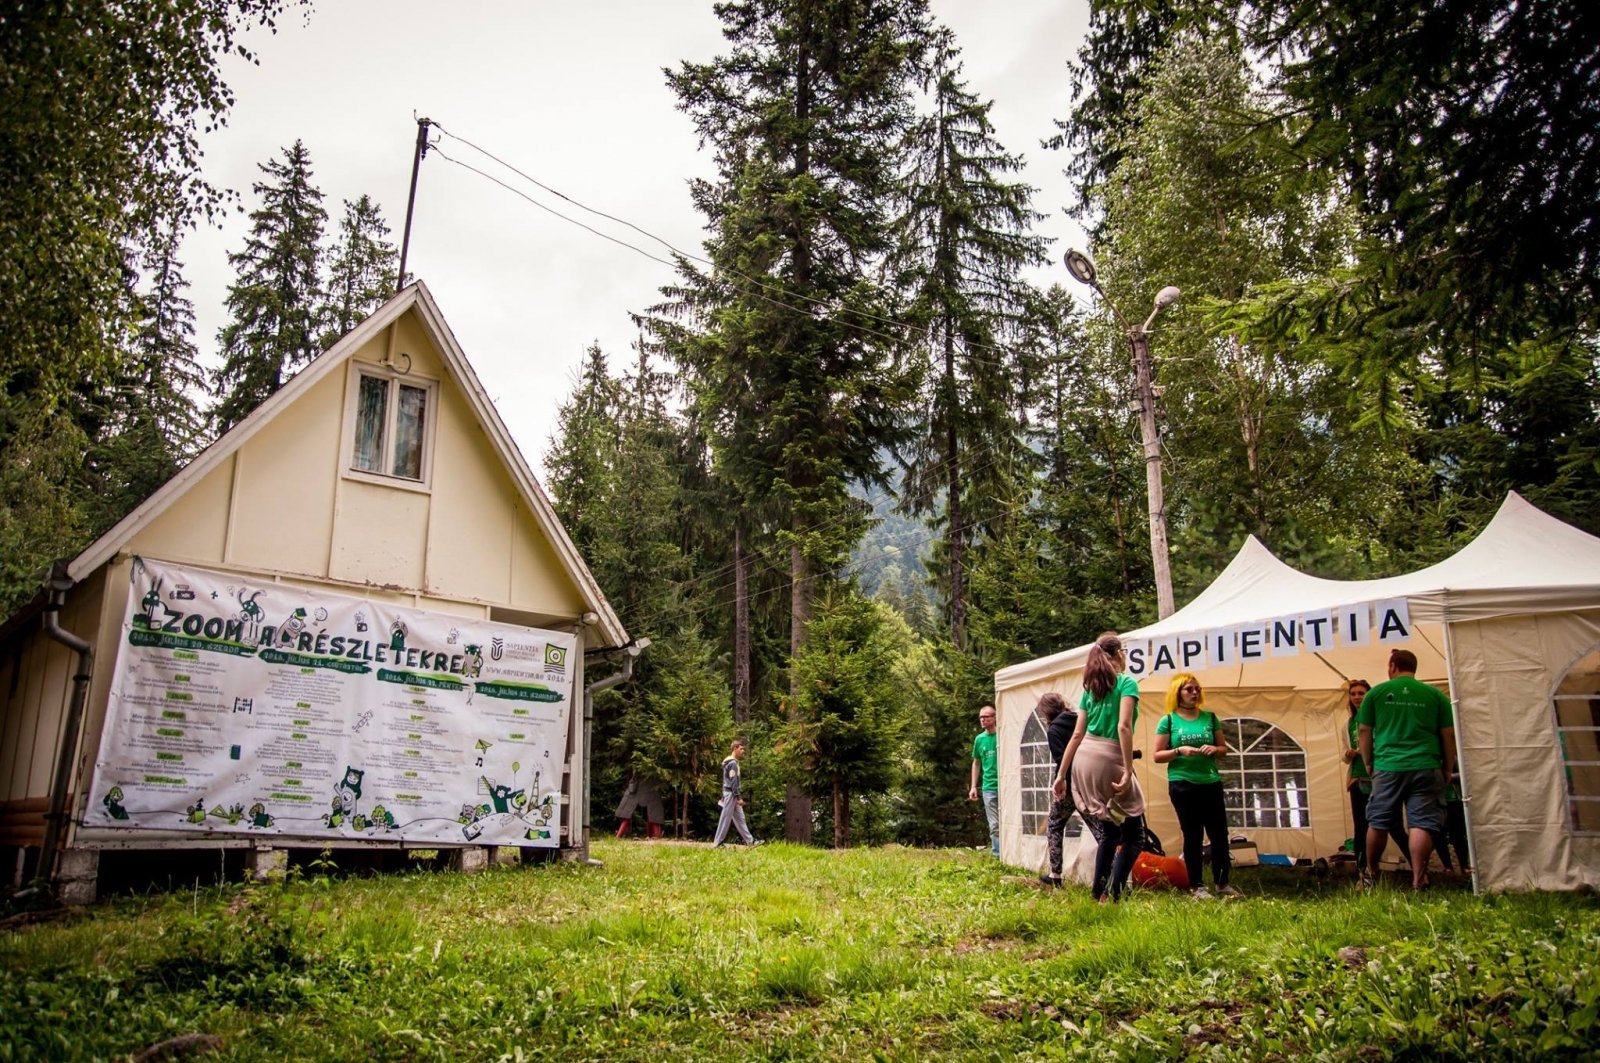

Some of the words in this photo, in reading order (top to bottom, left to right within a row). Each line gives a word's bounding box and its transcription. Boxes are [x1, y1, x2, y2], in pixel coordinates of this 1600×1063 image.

[162, 609, 244, 643] ZOOM
[297, 628, 464, 674] RÉSZLETEKRE
[1128, 608, 1409, 675] SAPIENTIA
